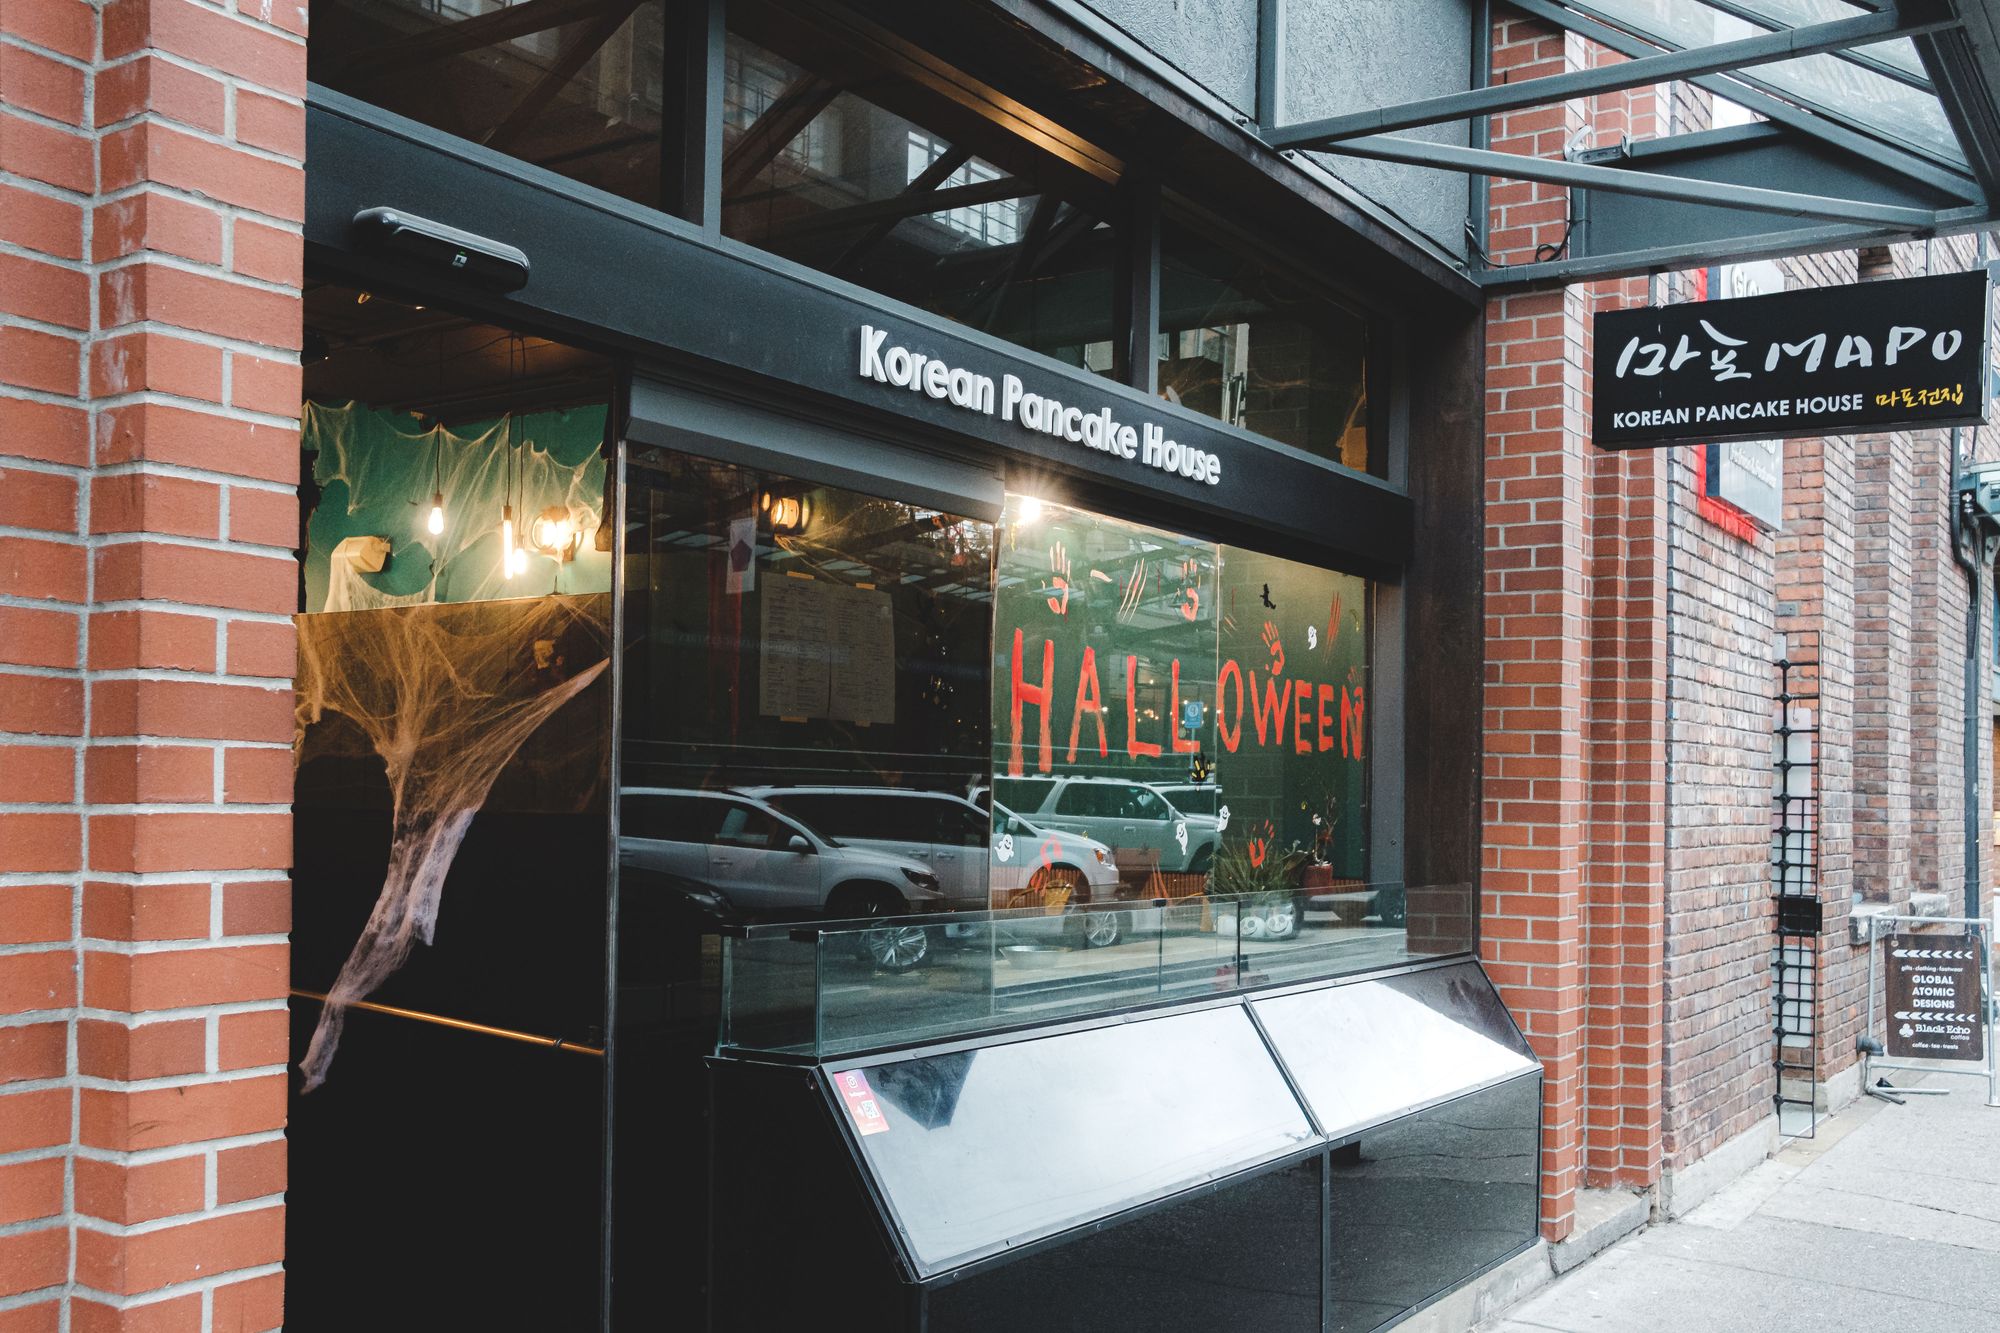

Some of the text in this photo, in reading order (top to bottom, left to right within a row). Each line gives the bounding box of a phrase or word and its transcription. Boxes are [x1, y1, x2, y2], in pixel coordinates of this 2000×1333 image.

[1615, 318, 1963, 382] 마포 MAPO
[858, 324, 1222, 485] Korean Pancake House
[1613, 383, 1964, 429] KOREAN PANCAKE HOUSE 마포전집
[1008, 628, 1365, 777] HALLOWEEN
[1912, 975, 1955, 985] GLOBAL
[1912, 987, 1955, 997] ATOMIC
[1913, 999, 1955, 1009] DESIGNS
[1915, 1023, 1971, 1035] Black Echo
